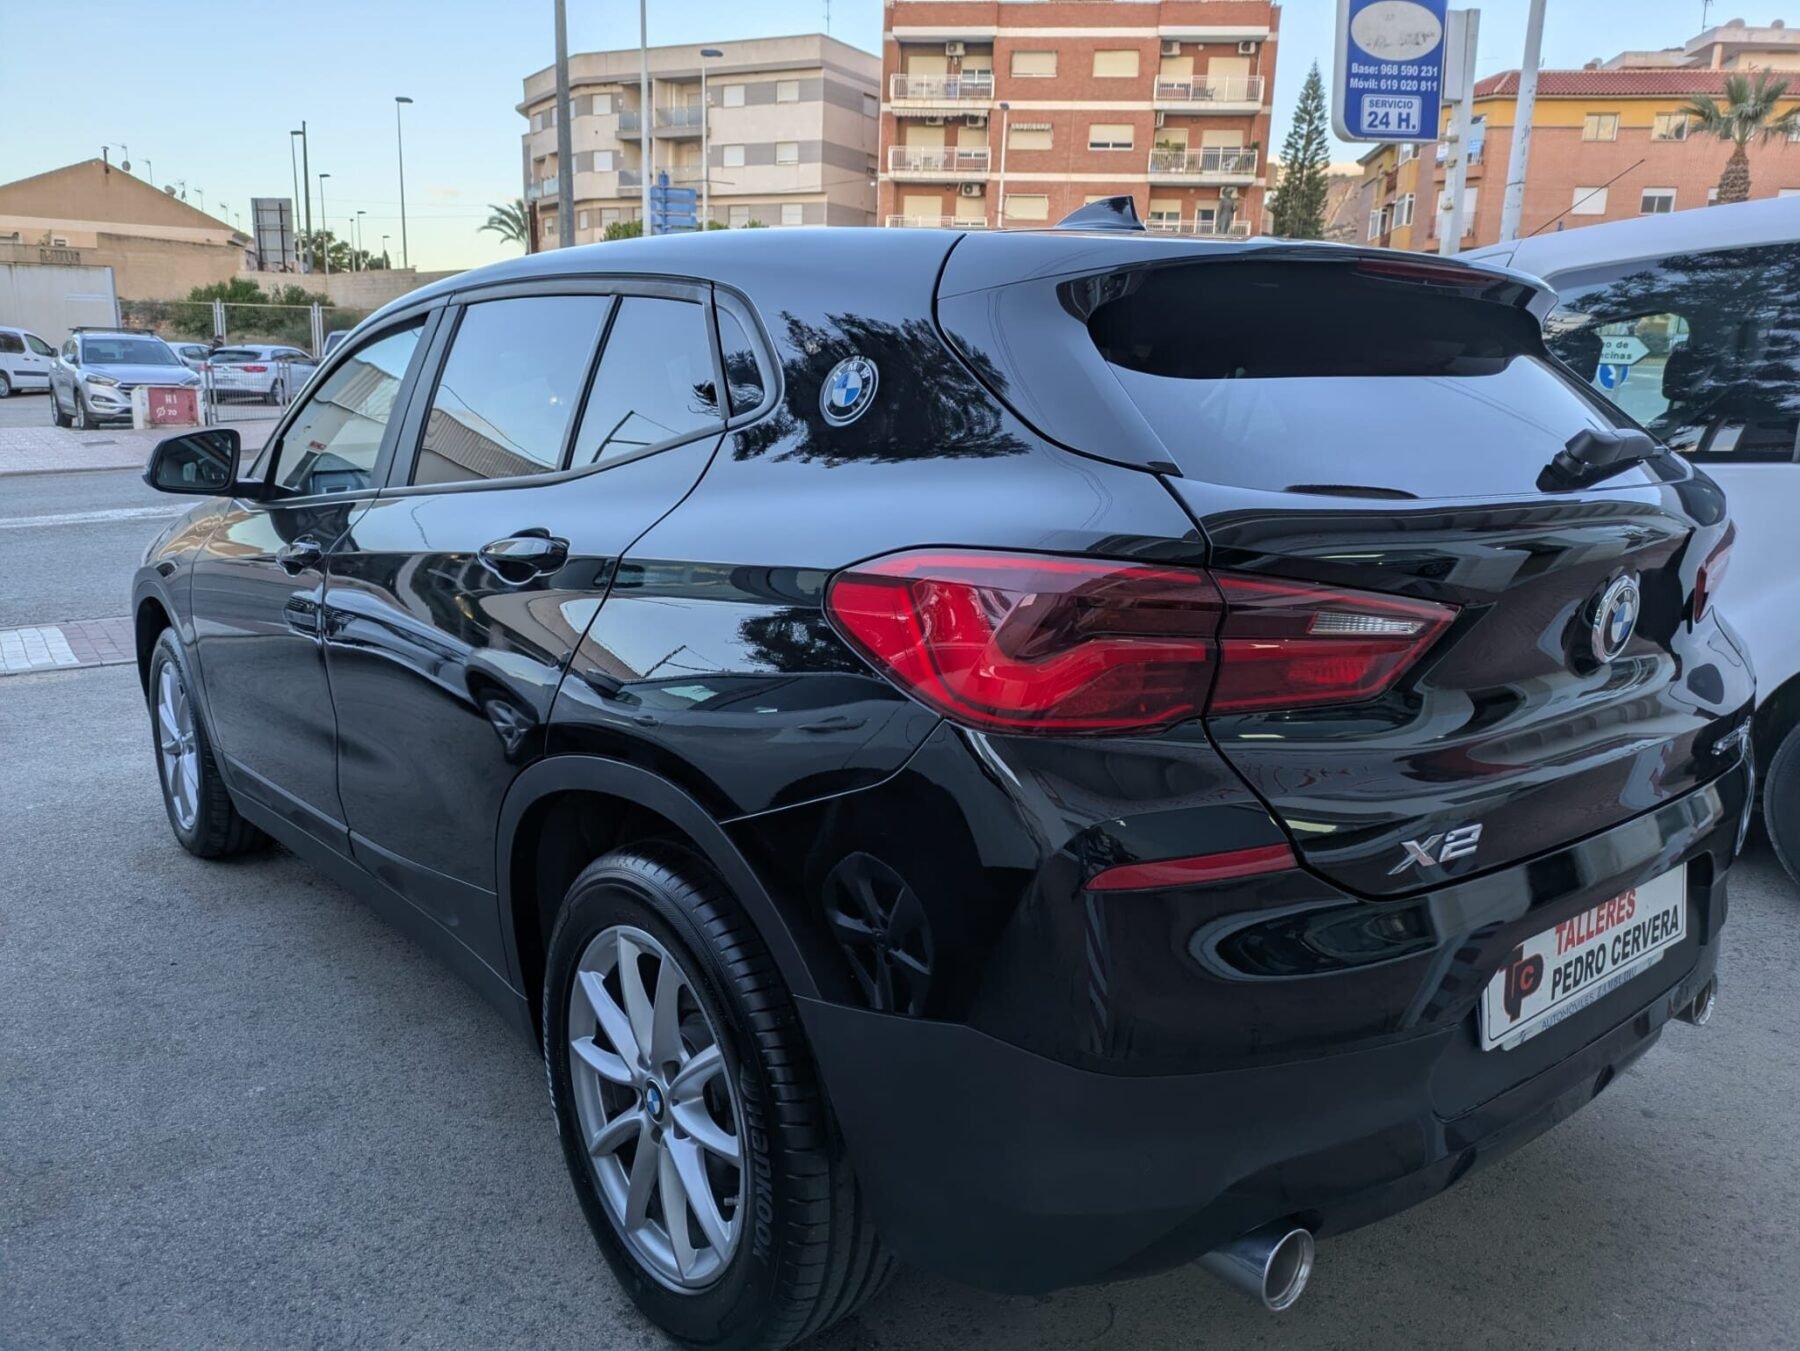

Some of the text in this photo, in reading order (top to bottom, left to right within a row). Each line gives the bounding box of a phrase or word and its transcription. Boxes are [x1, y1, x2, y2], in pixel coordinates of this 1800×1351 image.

[1352, 63, 1438, 77] Base: 968 590 231
[1350, 78, 1437, 91] Móvil: 619 020 811
[1369, 100, 1413, 109] SERVICIO
[1367, 111, 1417, 130] 24 H.
[1616, 341, 1629, 349] de
[1387, 824, 1483, 875] X2
[1555, 888, 1637, 956] TALLERES
[1551, 904, 1679, 1000] PEDRO CERVERA
